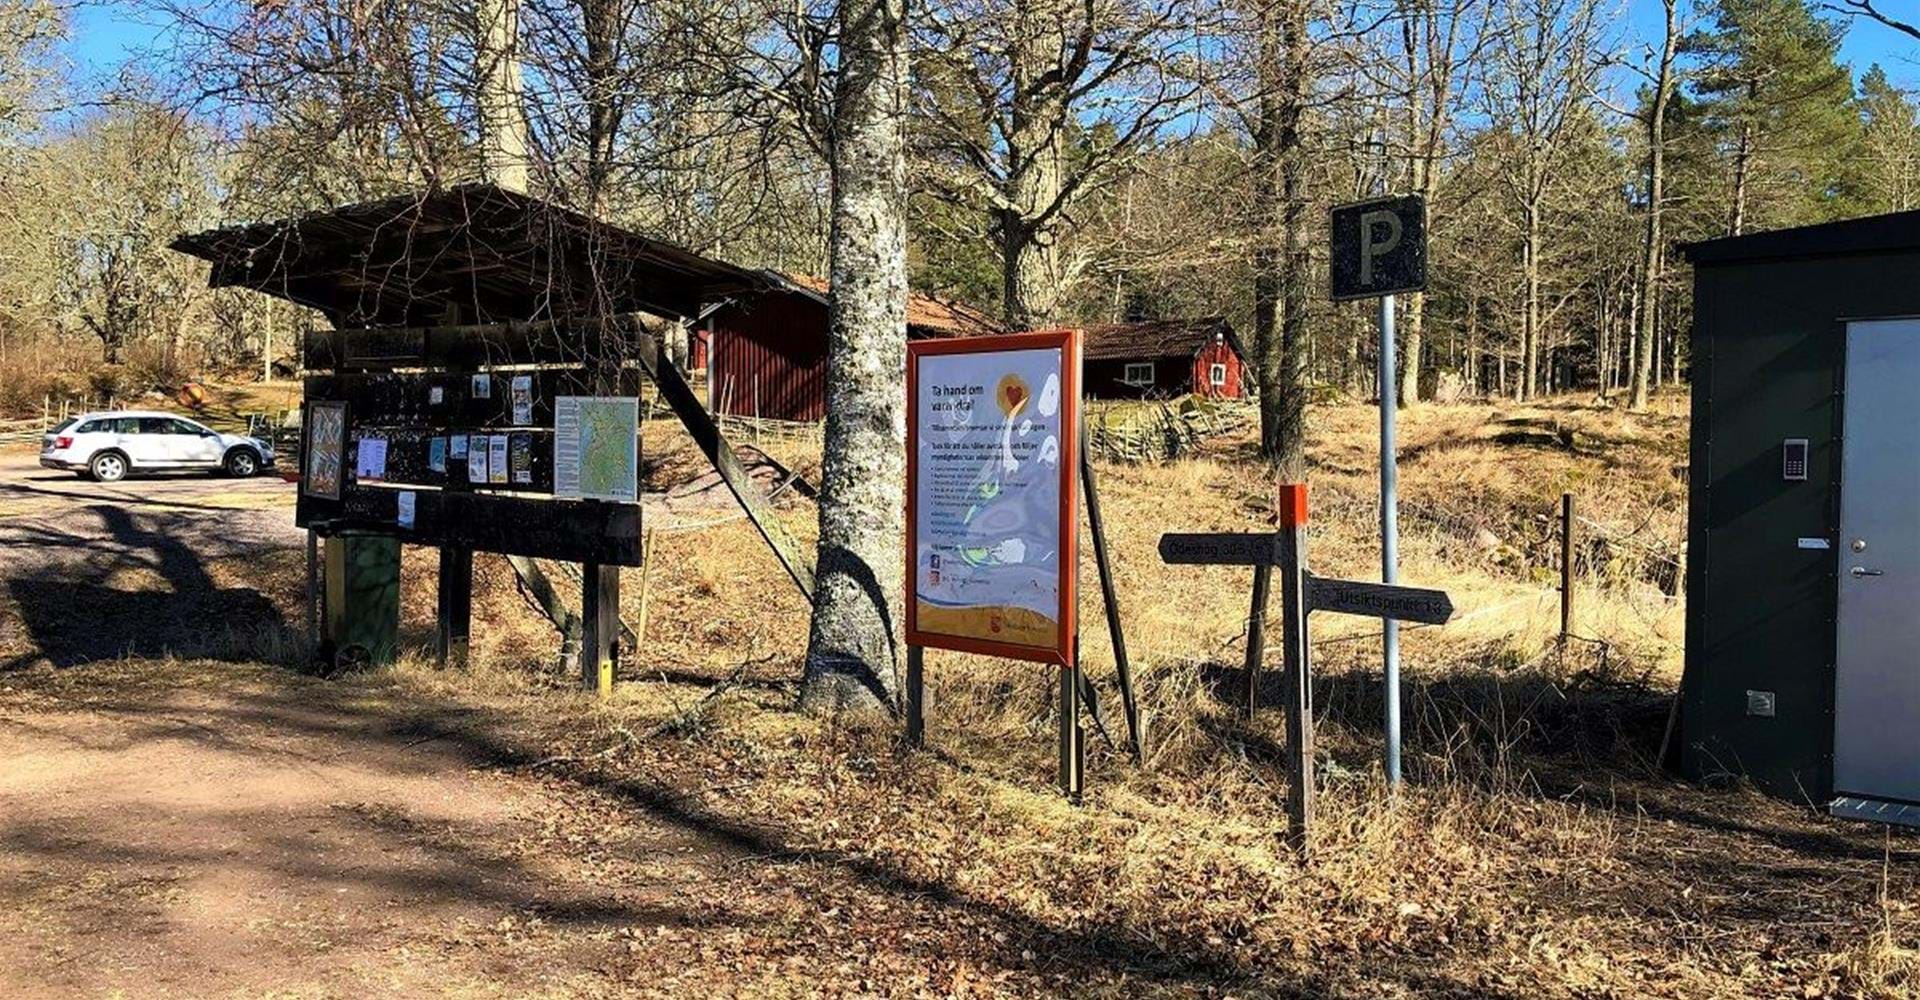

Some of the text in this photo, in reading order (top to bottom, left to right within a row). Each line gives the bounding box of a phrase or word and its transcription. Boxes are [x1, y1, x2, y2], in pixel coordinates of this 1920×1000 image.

[1360, 209, 1403, 285] P
[932, 384, 984, 397] Ta hand om
